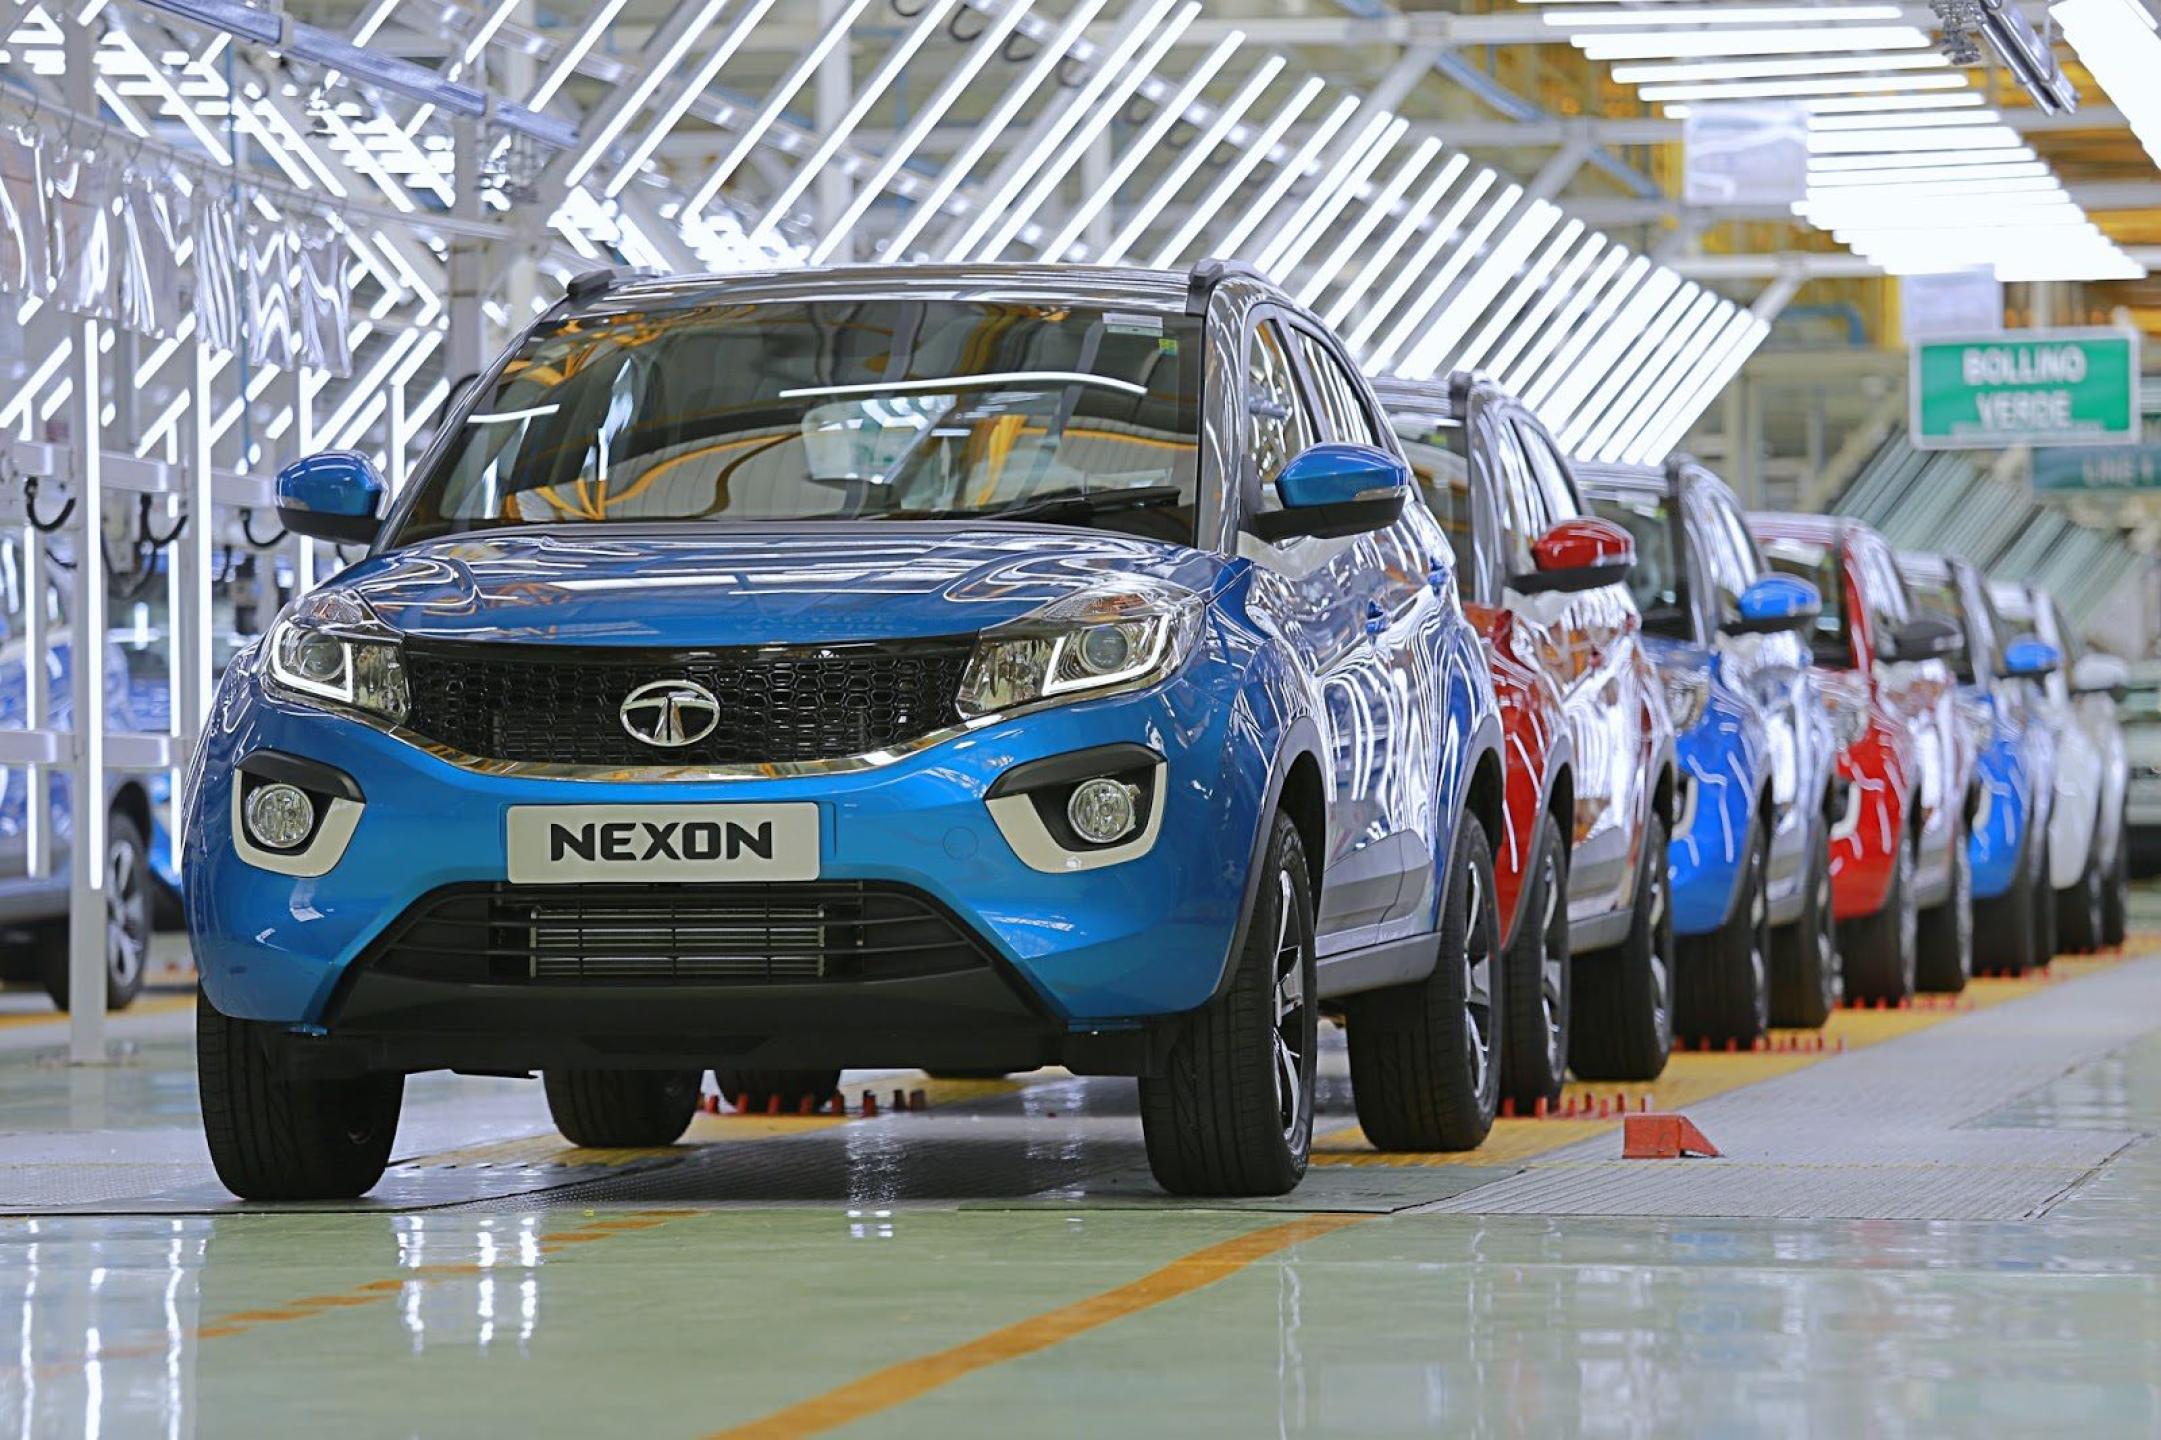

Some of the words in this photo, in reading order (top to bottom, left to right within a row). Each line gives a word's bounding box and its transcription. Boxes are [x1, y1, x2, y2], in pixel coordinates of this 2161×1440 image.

[1962, 344, 2087, 385] BOLLINO
[1976, 389, 2072, 430] VERDE
[551, 821, 772, 862] NEXON
